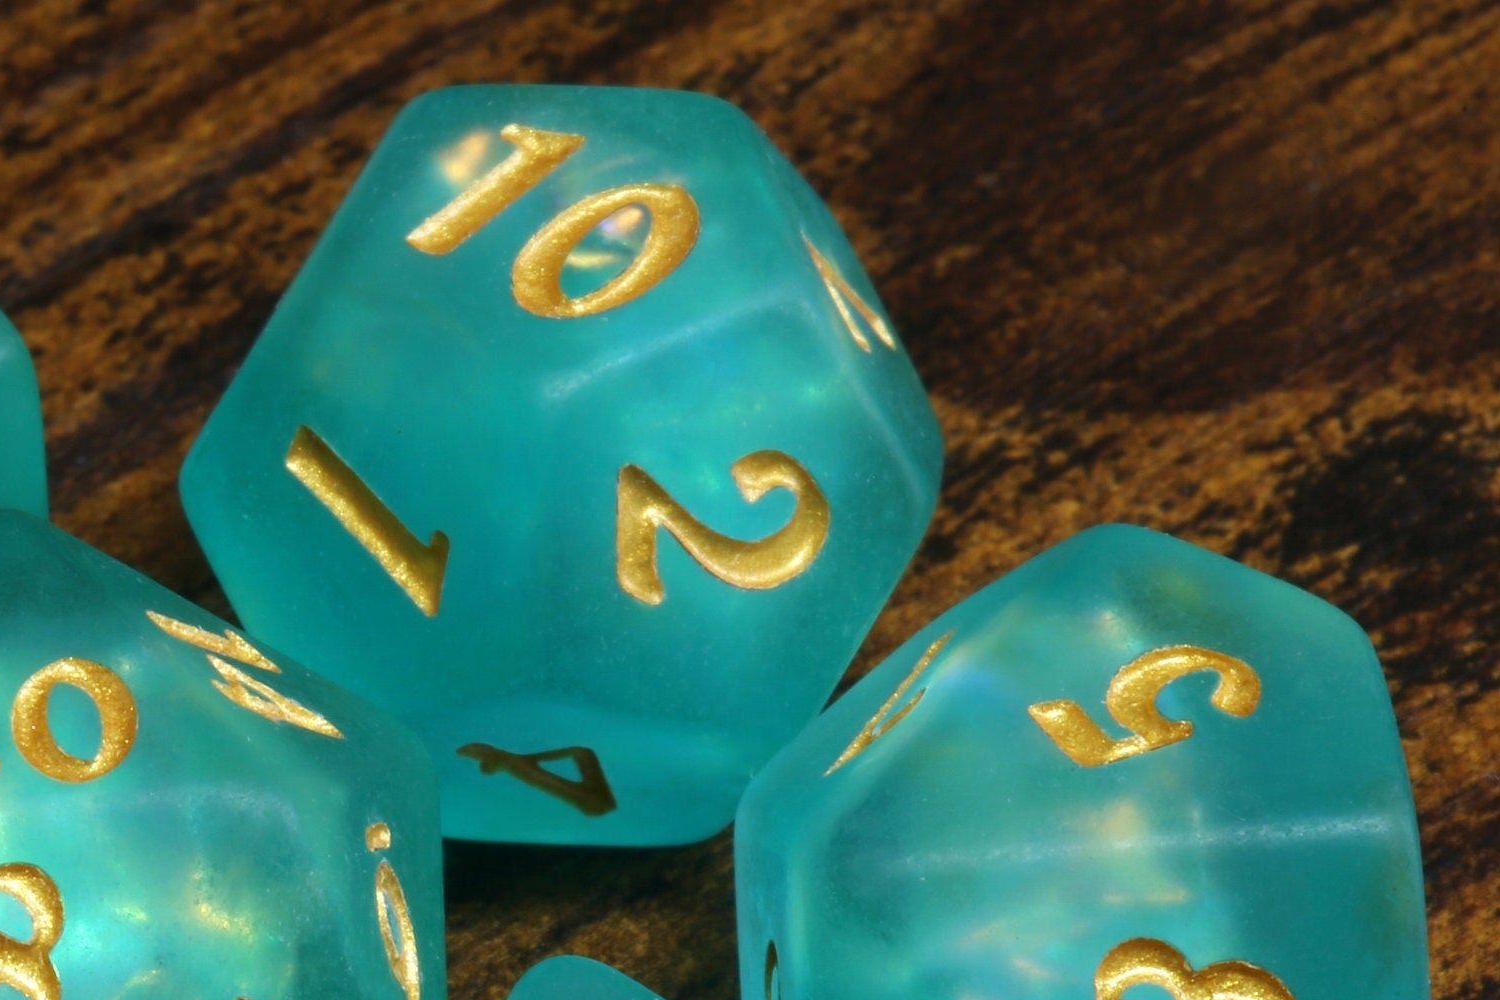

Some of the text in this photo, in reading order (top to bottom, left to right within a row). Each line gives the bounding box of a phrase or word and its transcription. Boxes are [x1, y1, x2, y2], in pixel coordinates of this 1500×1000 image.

[405, 123, 701, 319] 10
[285, 424, 451, 617] 1
[615, 450, 831, 604] 2
[455, 742, 619, 816] 4
[1027, 643, 1262, 767] 5
